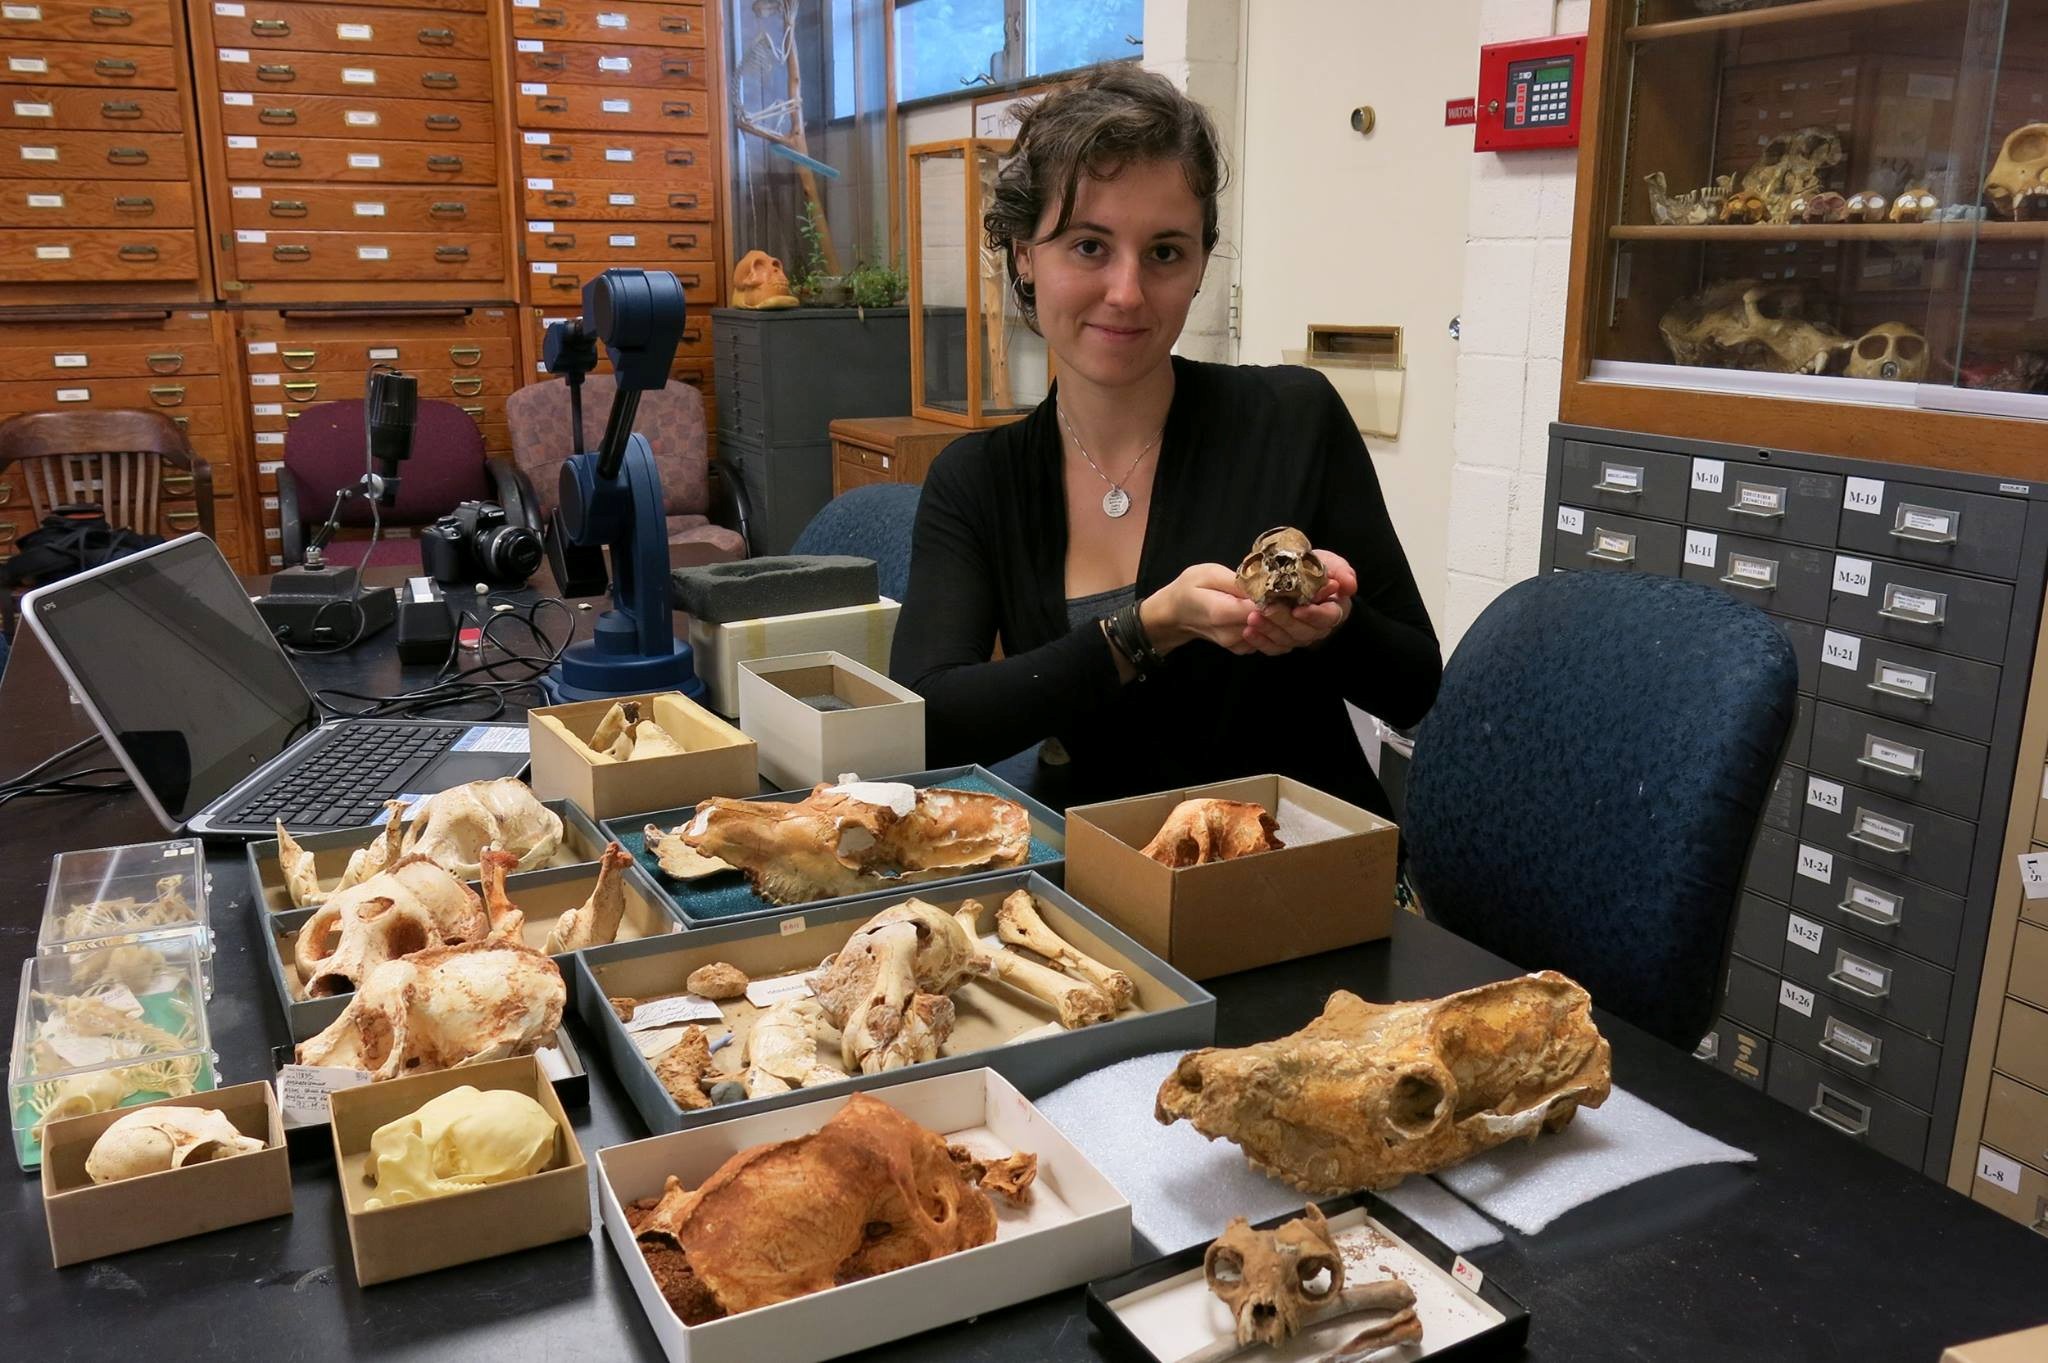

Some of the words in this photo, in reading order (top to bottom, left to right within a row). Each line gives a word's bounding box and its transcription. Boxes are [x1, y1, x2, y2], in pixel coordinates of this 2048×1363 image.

[1448, 106, 1474, 119] WATCH
[1695, 471, 1719, 484] M-10
[1849, 491, 1877, 505] M-19
[1560, 514, 1577, 526] M-2
[1689, 543, 1712, 557] M-11
[1839, 571, 1866, 586] M-20
[1827, 645, 1853, 661] M-21
[1896, 677, 1913, 686] EMPTY
[1880, 750, 1898, 758] EMPTY
[1811, 790, 1838, 806] M-23
[1803, 857, 1829, 873] M-24
[2026, 859, 2042, 882] L-5
[1793, 924, 1819, 942] M-25
[1784, 988, 1810, 1008] M-26
[1984, 1164, 2004, 1182] L-8
